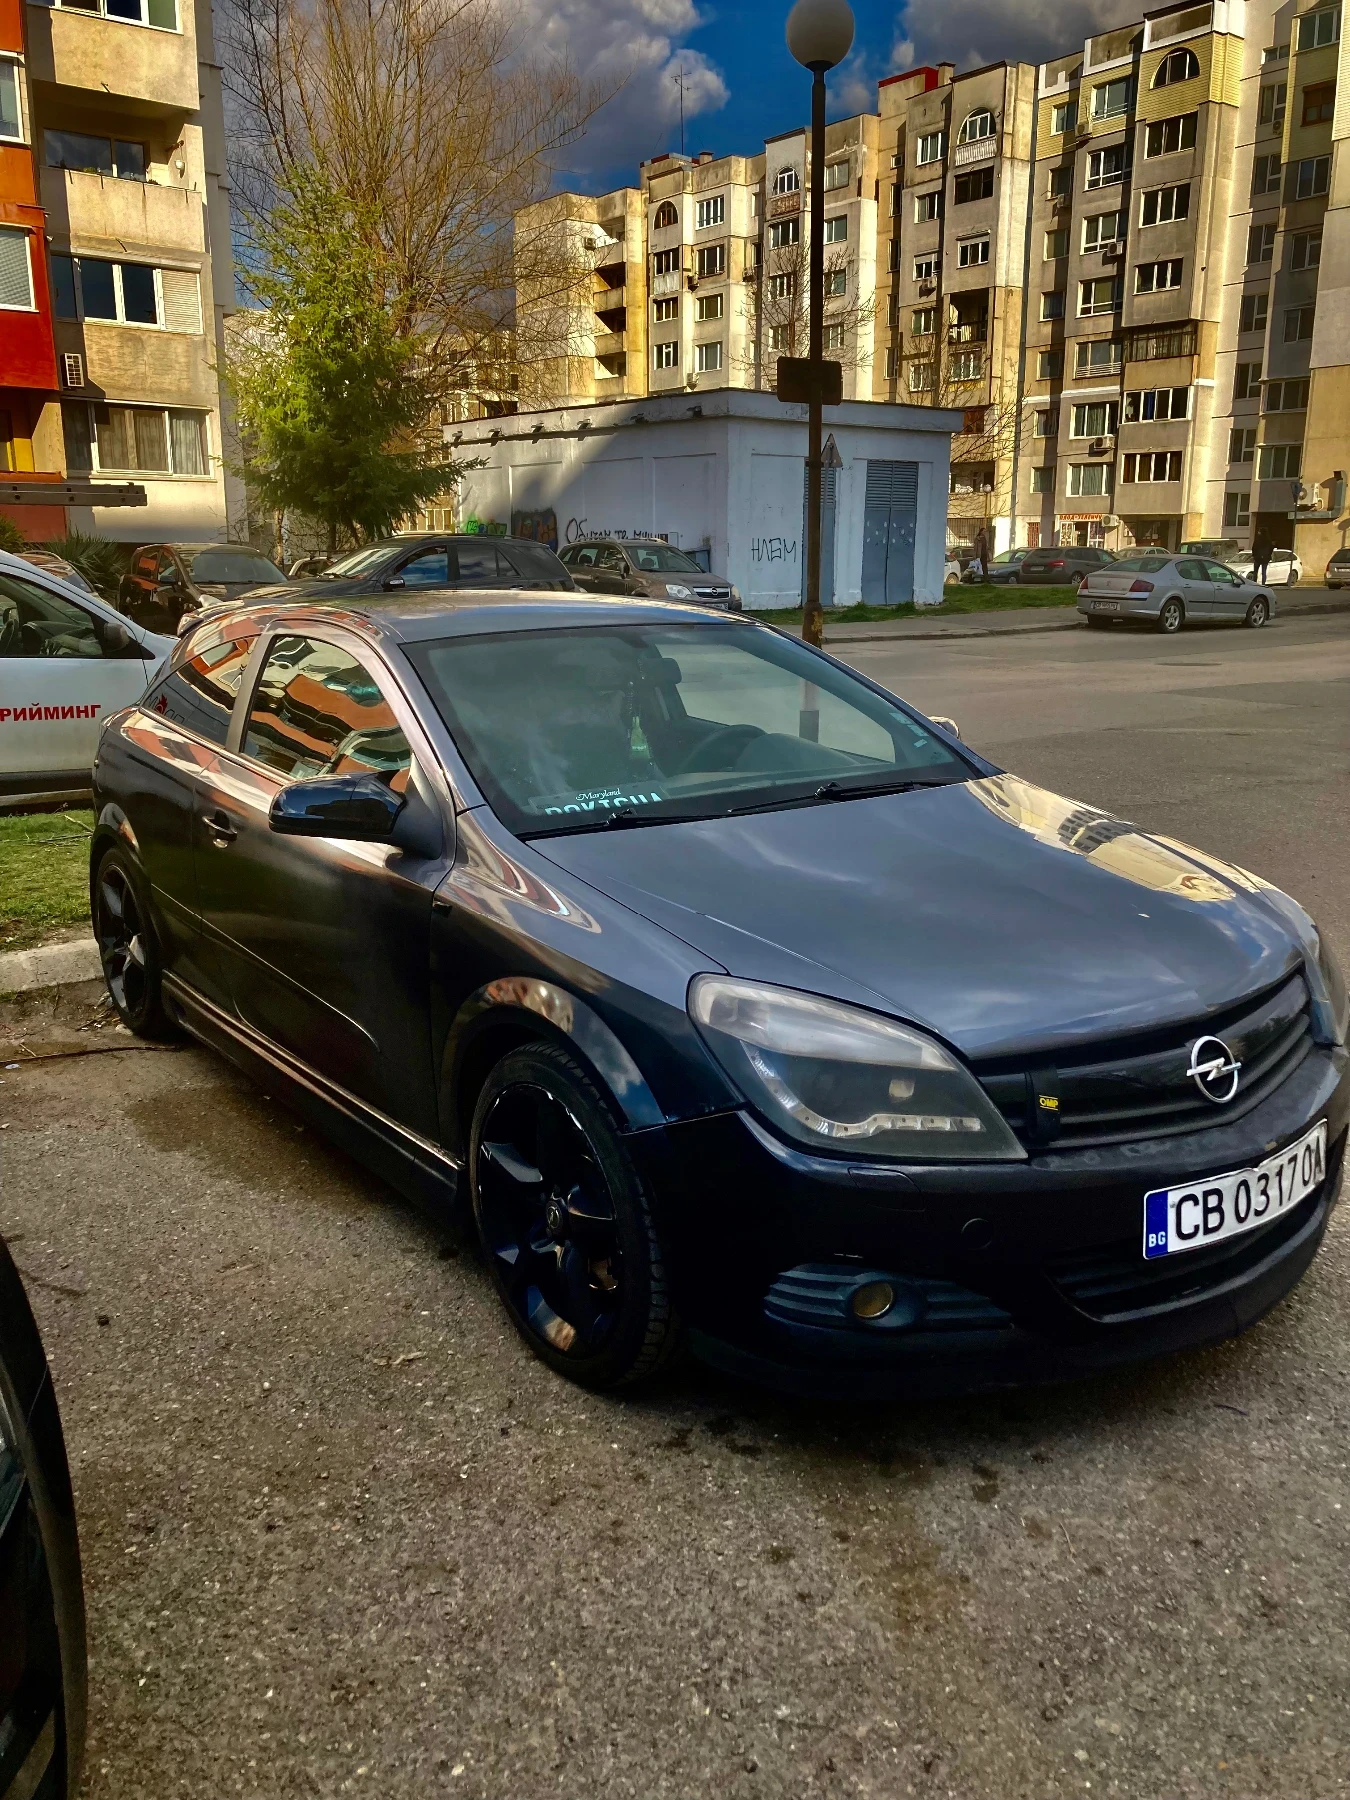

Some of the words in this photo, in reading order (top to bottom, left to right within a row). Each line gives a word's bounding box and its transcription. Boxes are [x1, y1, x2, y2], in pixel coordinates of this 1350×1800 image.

[0, 703, 101, 722] РИЙМИНГ
[575, 788, 621, 801] Maryland
[1040, 1098, 1058, 1108] OMP
[1175, 1187, 1225, 1241] CB
[1148, 1231, 1166, 1248] BG
